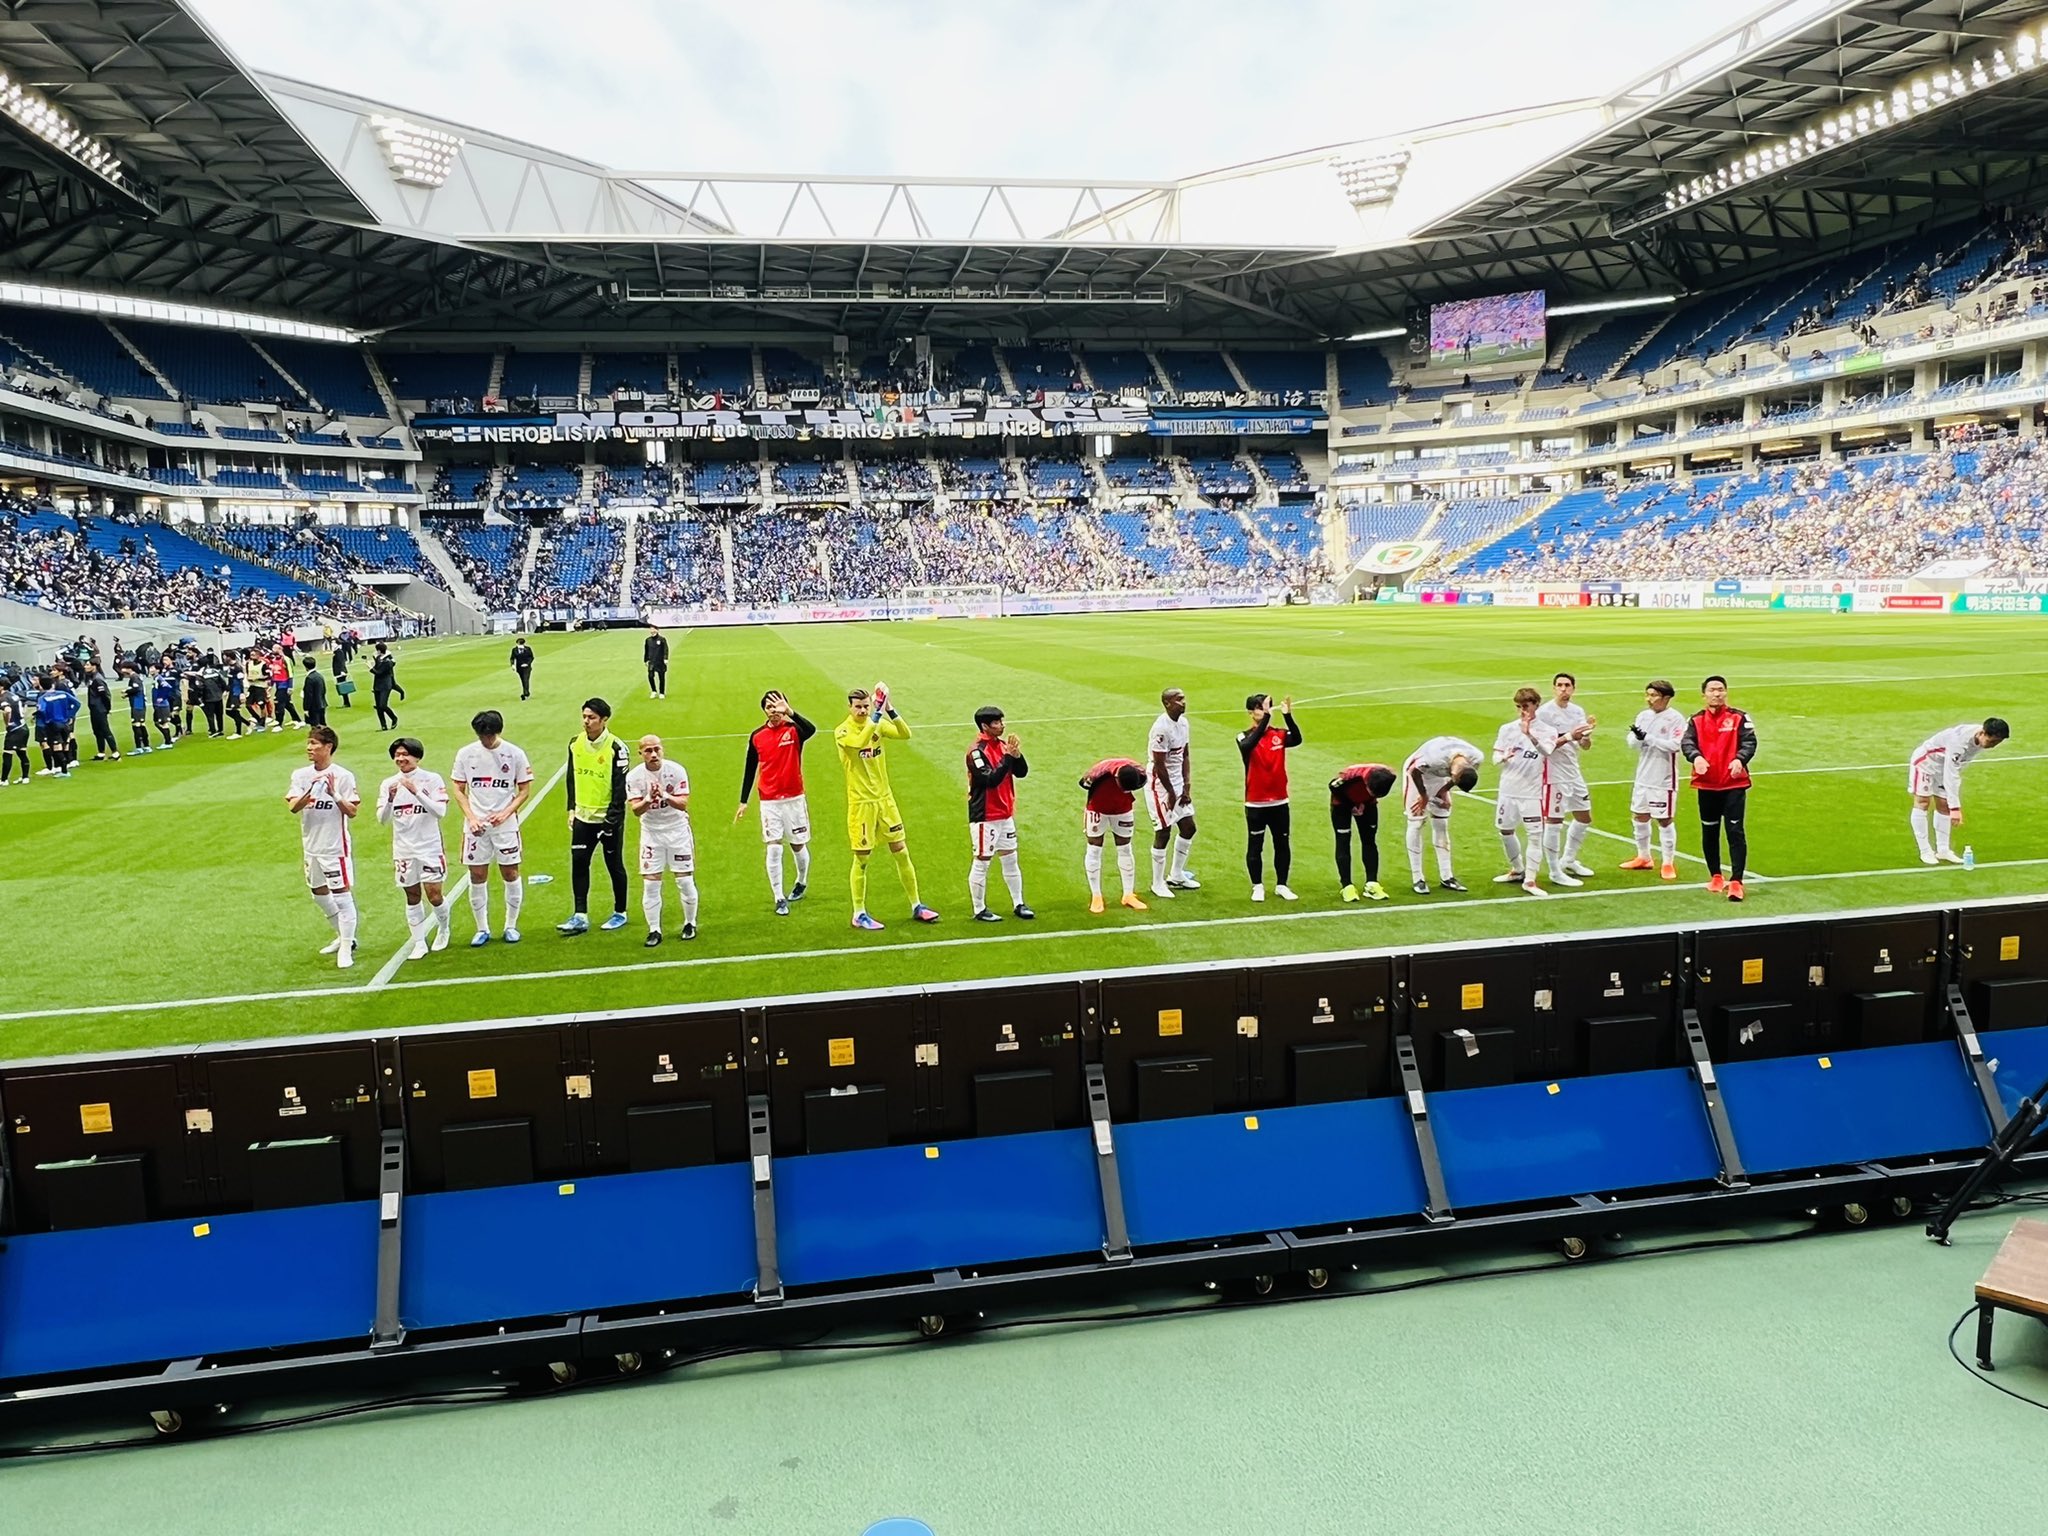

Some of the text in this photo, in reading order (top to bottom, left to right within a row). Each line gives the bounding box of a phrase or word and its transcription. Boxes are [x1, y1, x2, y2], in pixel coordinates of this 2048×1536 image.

[556, 407, 1153, 426] NORTH FACE
[483, 426, 607, 442] NEROBLISTA
[832, 423, 920, 440] BRIGATE
[1209, 597, 1258, 606] Panasonic
[1543, 593, 1580, 606] KONAMI
[1966, 595, 2042, 612] 明治安田生命
[869, 608, 900, 617] TOYO
